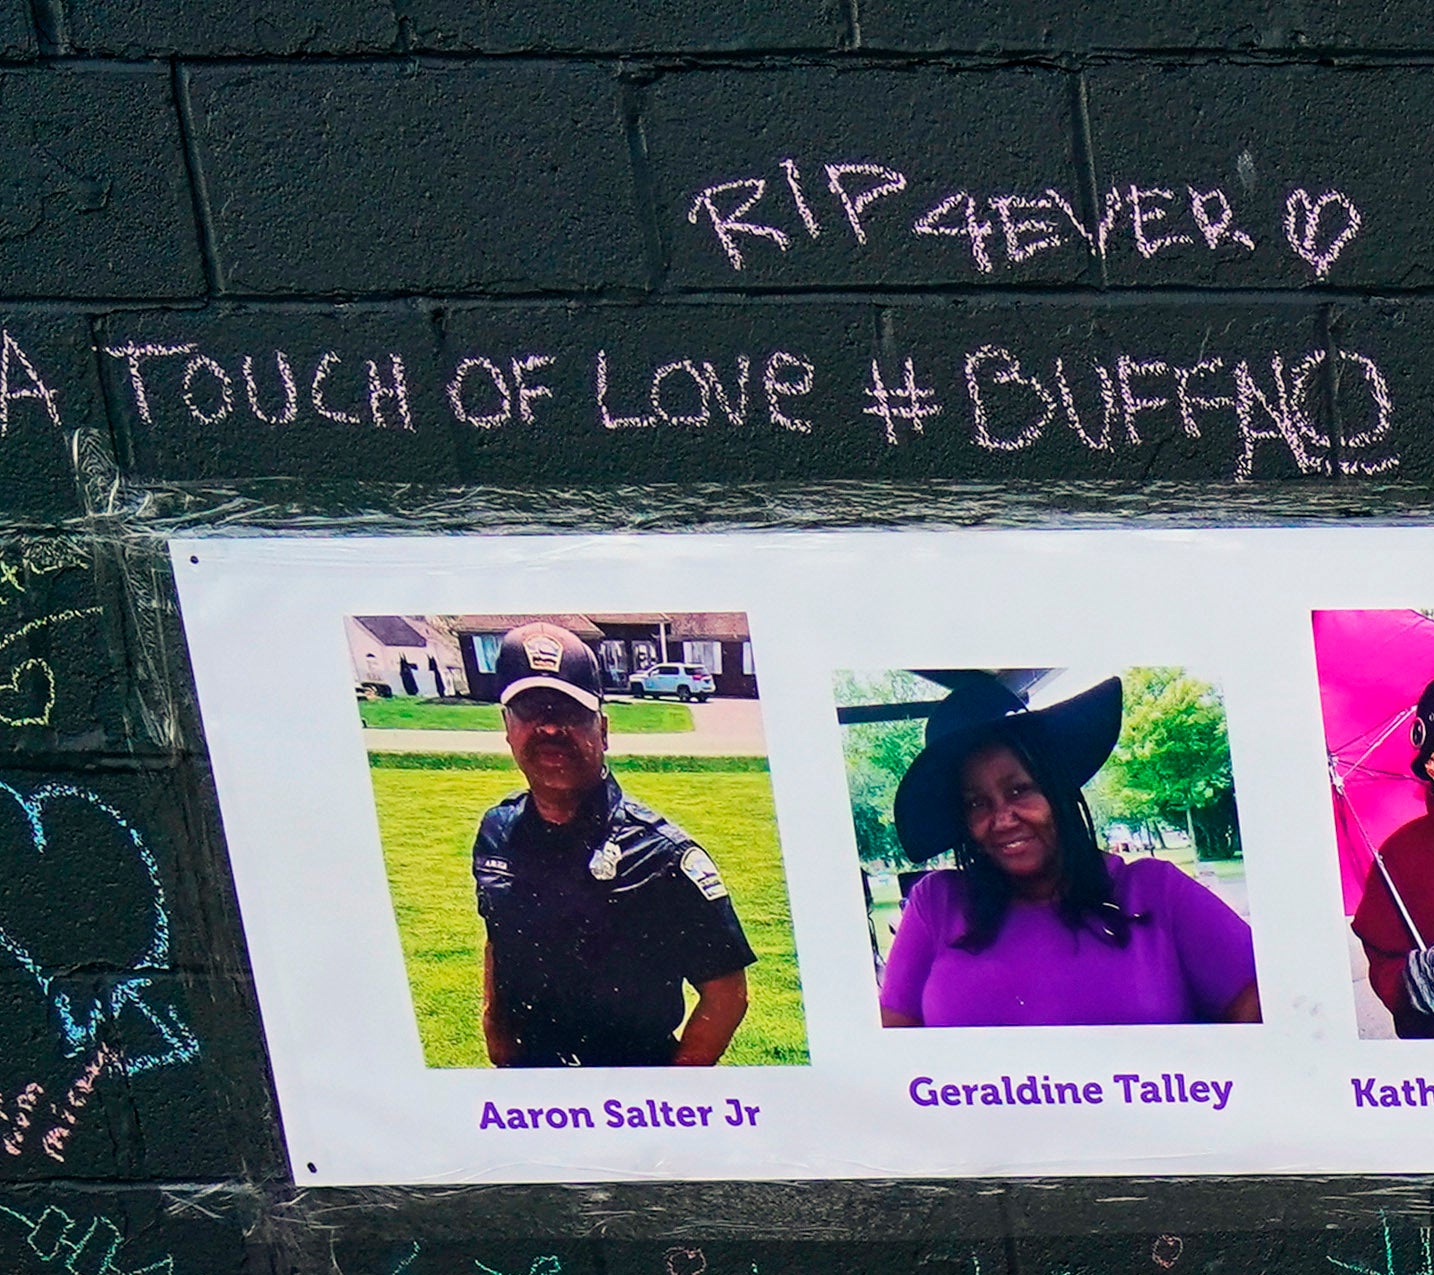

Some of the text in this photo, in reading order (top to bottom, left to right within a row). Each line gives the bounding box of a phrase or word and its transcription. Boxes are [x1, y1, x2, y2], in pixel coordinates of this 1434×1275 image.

[687, 158, 1255, 275] RIP 4EVER
[91, 340, 417, 435] TOUCH
[447, 352, 557, 430] OF
[596, 349, 813, 434] LOVE
[479, 1098, 761, 1130] Aaron Salter Jr
[908, 1073, 1234, 1111] Geraldine Talley
